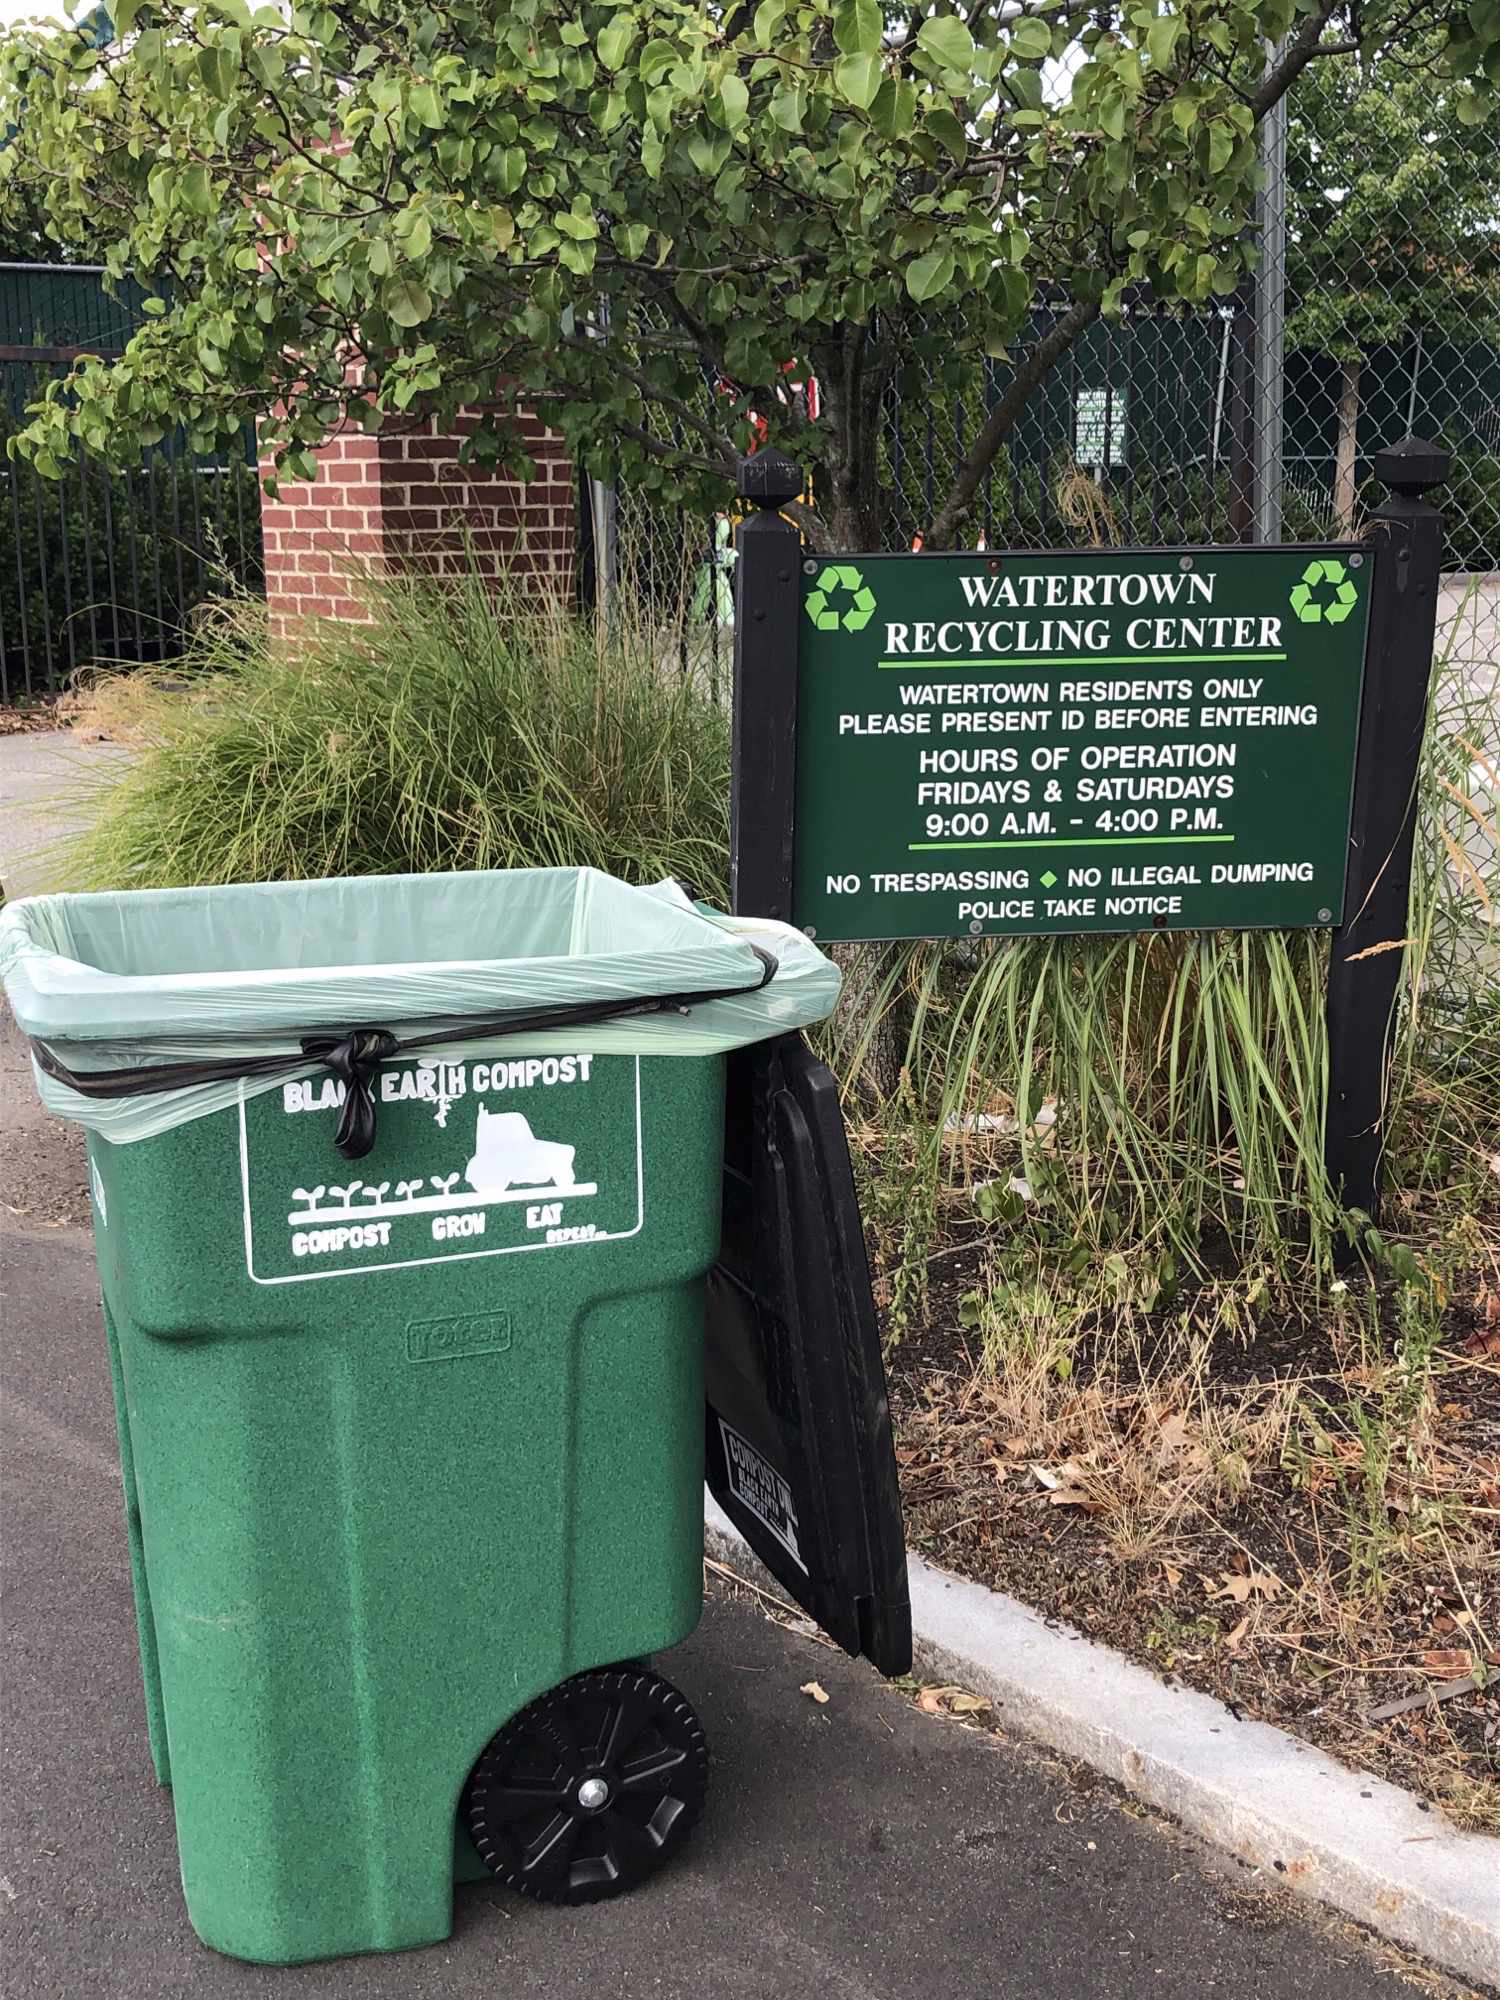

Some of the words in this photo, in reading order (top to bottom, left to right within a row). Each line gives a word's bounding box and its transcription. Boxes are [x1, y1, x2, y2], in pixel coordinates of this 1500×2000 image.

[958, 573, 1217, 608] WATERTOWN
[883, 619, 1111, 654] RECYCLING
[1126, 616, 1283, 650] CENTER
[899, 682, 1049, 706] WATERTOWN
[1059, 679, 1193, 703] RESIDENTS
[1202, 678, 1264, 700] ONLY
[839, 712, 932, 735] PLEASE
[941, 710, 1053, 733] PRESENT
[1061, 709, 1085, 731] ID
[1094, 707, 1191, 730] BEFORE
[1200, 704, 1318, 728] ENTERING
[919, 747, 1019, 774] HOURS
[1030, 746, 1070, 772] OF
[1080, 743, 1237, 770] OPERATION
[917, 779, 1031, 806] FRIDAYS
[1043, 779, 1063, 803] &
[1076, 774, 1234, 802] SATURDAYS
[925, 812, 989, 837] 9:00
[999, 811, 1057, 835] A.M.
[1095, 808, 1159, 833] 4:00
[1170, 807, 1223, 831] P.M.
[826, 874, 861, 895] NO
[869, 869, 1030, 893] TRESPASSING
[1067, 867, 1102, 888] NO
[1110, 865, 1202, 886] ILLEGAL
[1210, 862, 1314, 884] DUMPING
[958, 900, 1035, 920] POLICE
[1043, 898, 1097, 917] TAKE
[1104, 895, 1183, 916] NOTICE
[283, 1076, 376, 1114] BLA
[380, 1060, 467, 1102] EARTH
[472, 1054, 593, 1093] COMPOST
[291, 1221, 392, 1257] COMPOST
[431, 1211, 486, 1241] GROW
[526, 1202, 564, 1229] EAT
[728, 1433, 778, 1500] COMPOST
